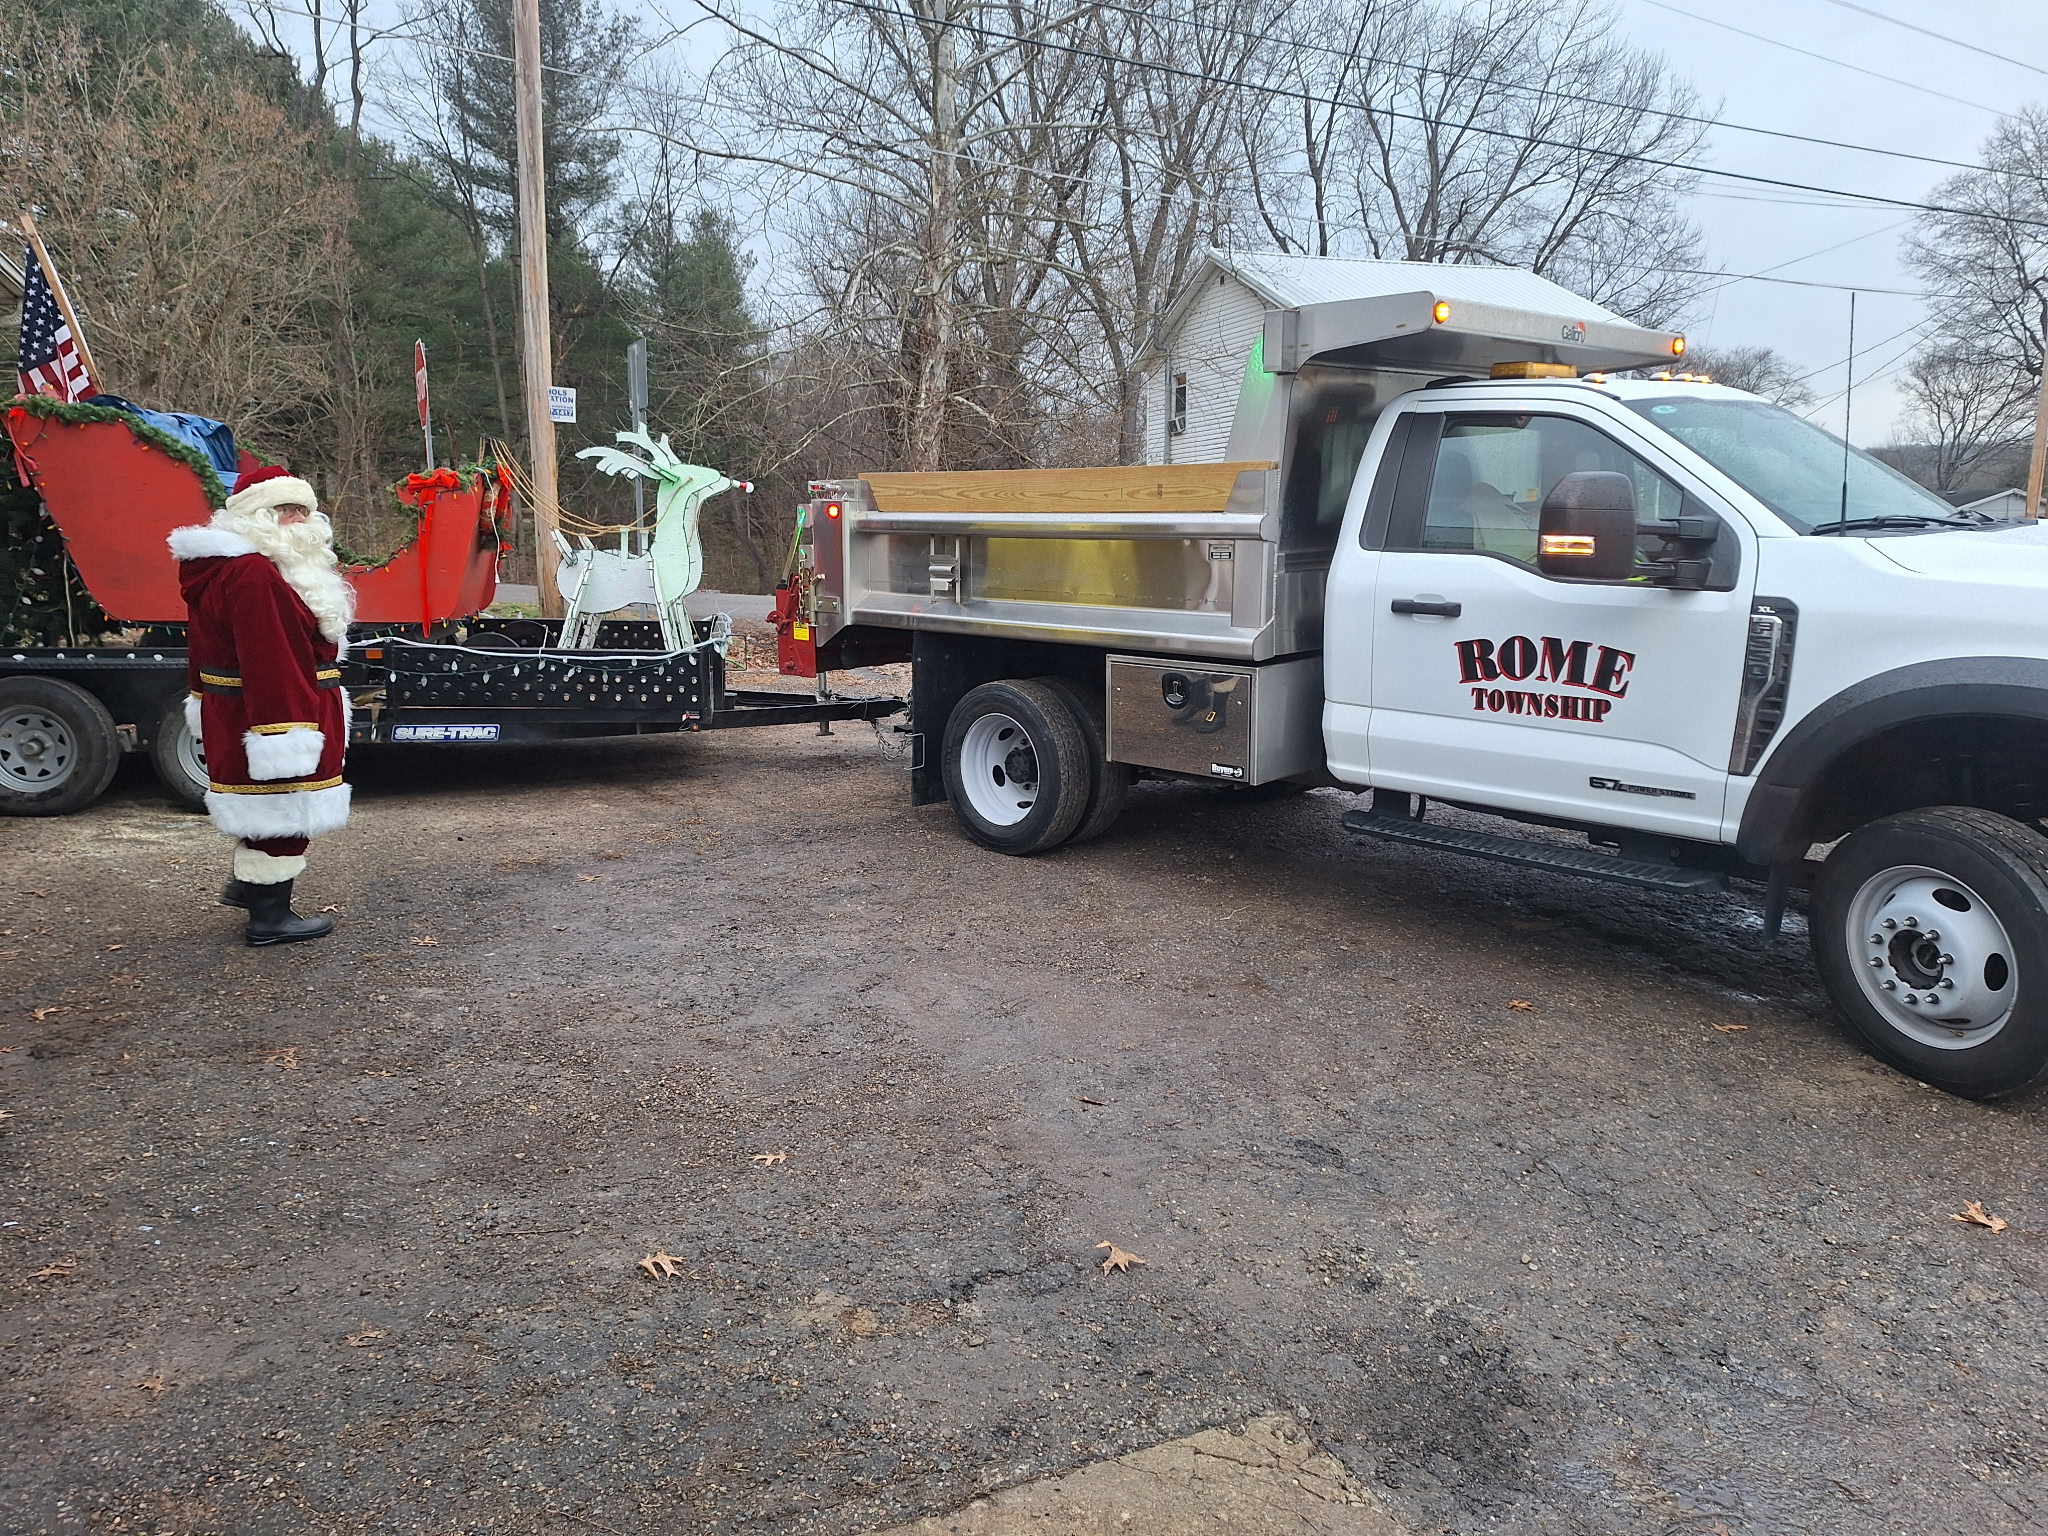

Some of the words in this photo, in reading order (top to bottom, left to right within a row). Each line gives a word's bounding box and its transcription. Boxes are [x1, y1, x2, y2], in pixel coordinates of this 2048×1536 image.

[1757, 605, 1775, 613] XL
[1454, 635, 1636, 699] ROME
[1471, 688, 1612, 722] TOWNSHIP
[395, 727, 497, 740] SURE-TRAC
[1628, 785, 1657, 795] POWER
[1660, 789, 1693, 799] STROKE
